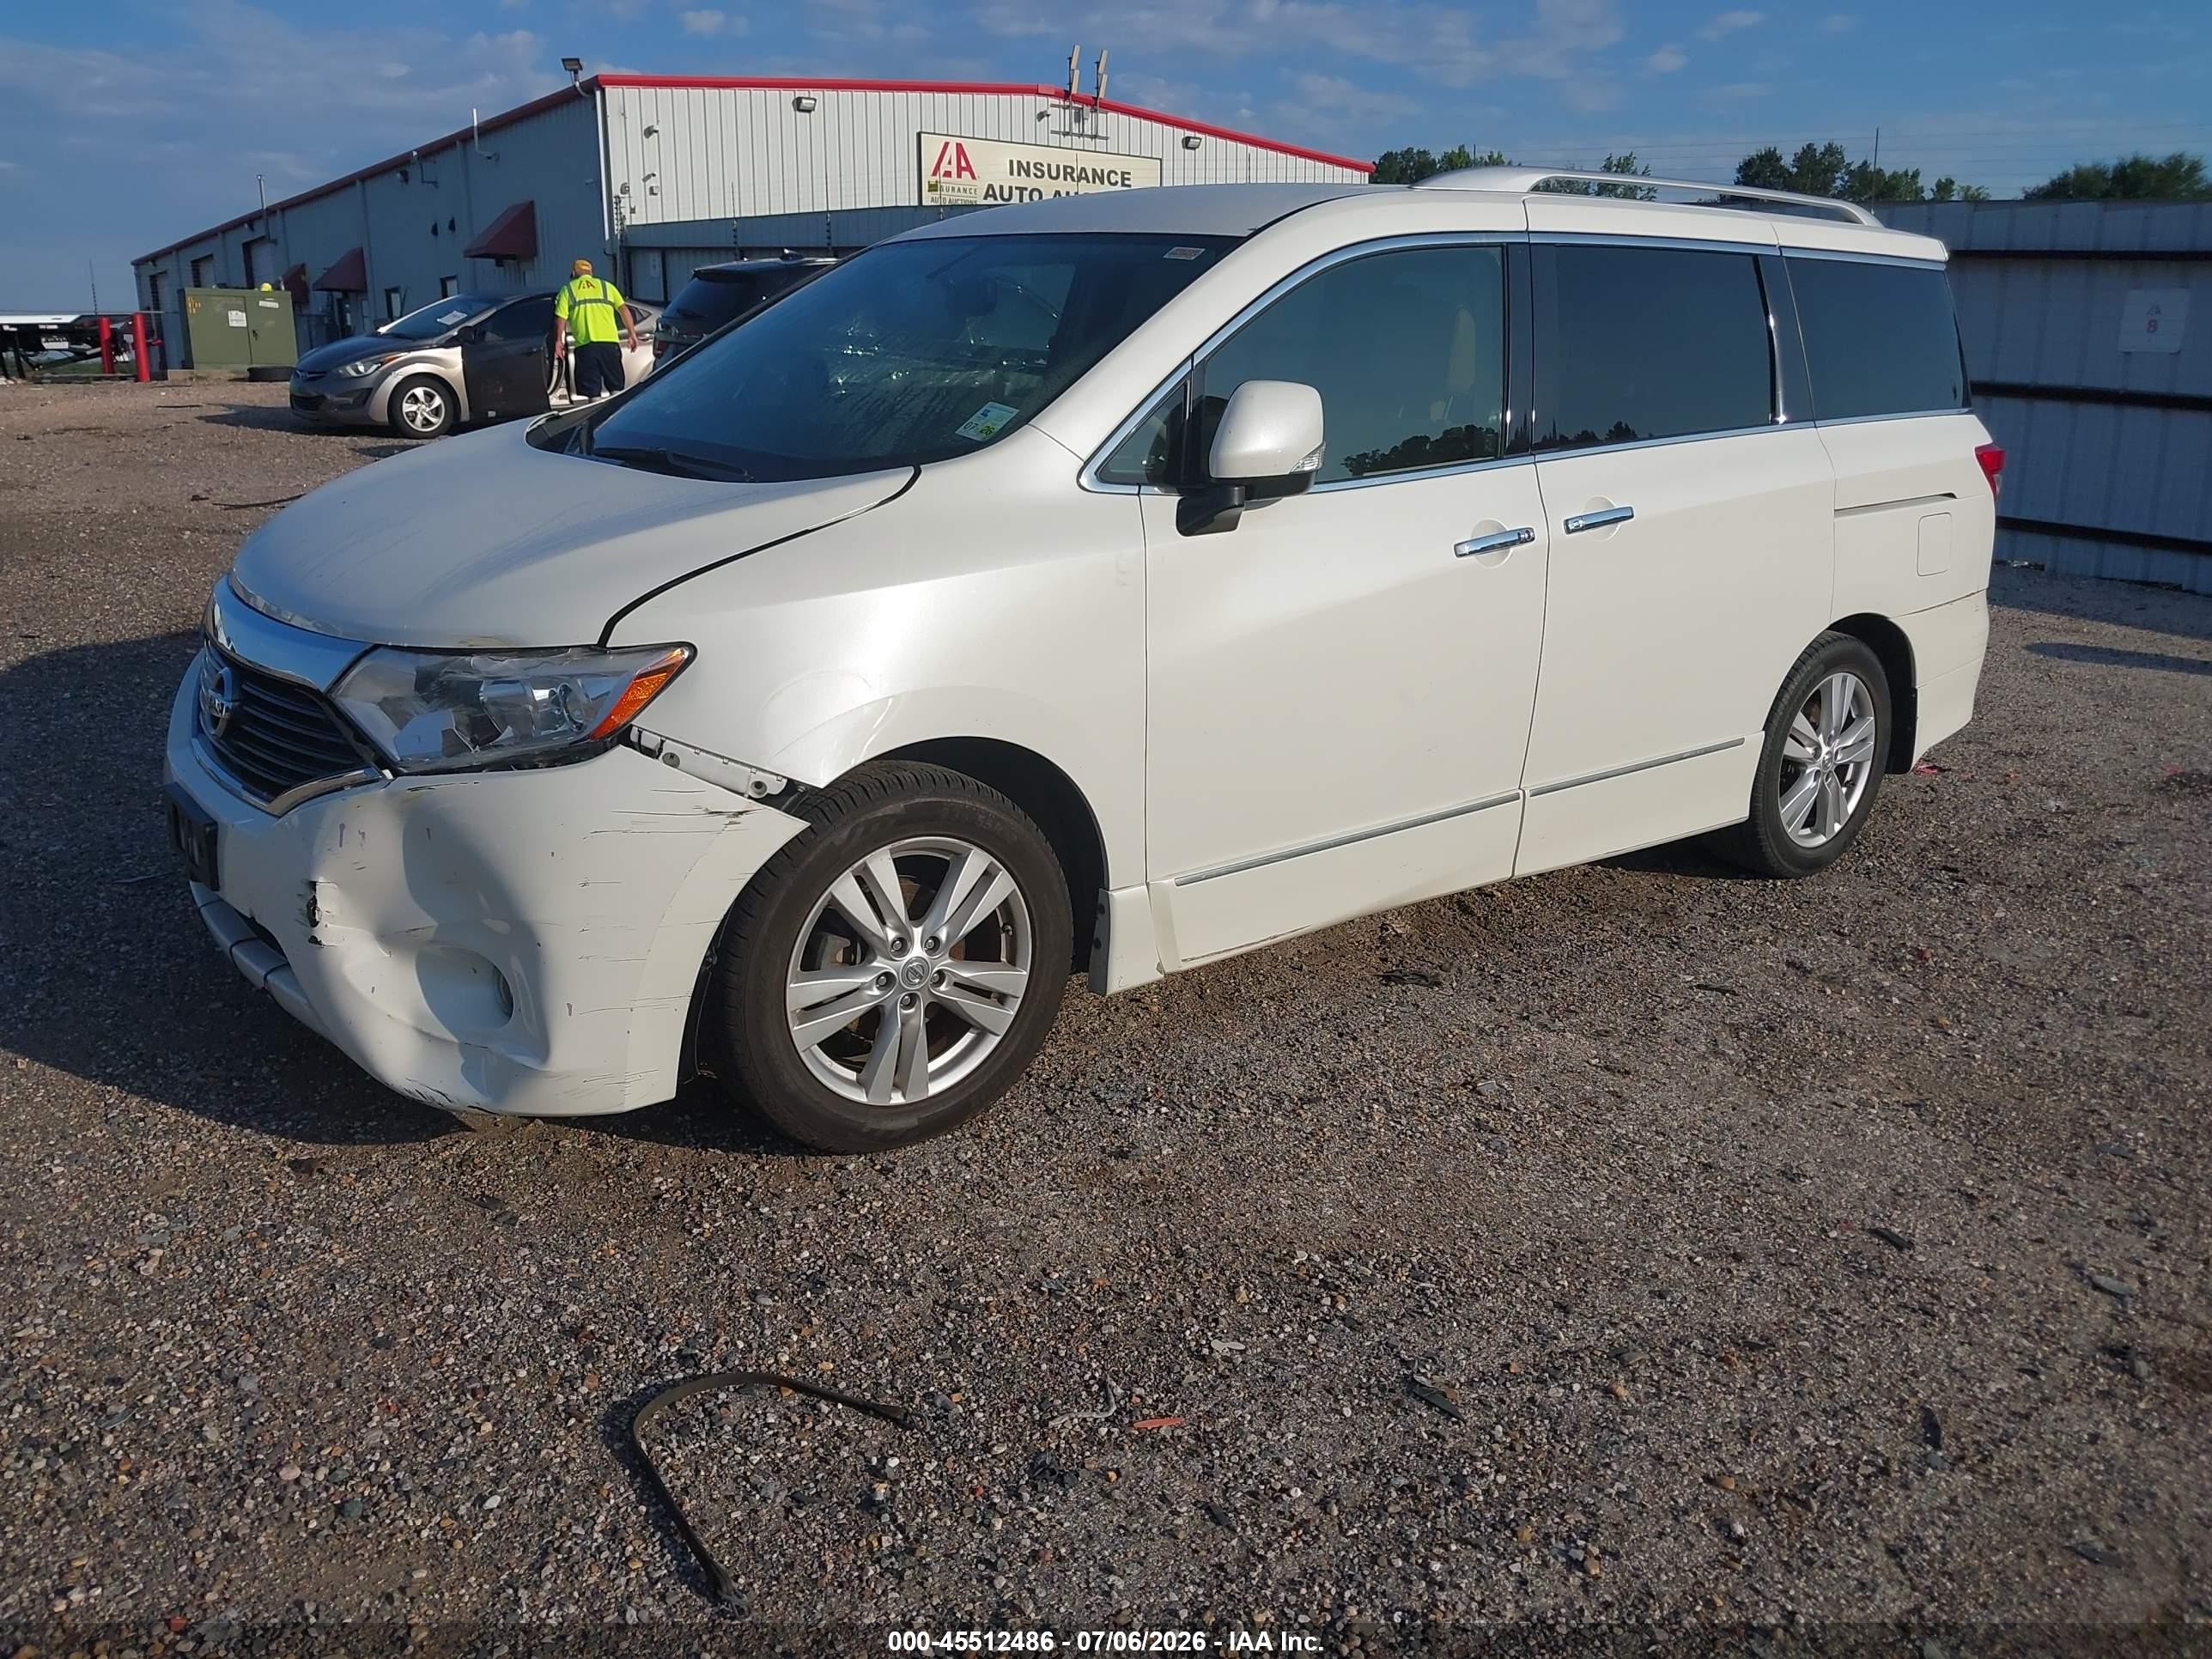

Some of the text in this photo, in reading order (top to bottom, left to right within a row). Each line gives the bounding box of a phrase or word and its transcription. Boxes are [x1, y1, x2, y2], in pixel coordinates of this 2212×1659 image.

[1009, 159, 1132, 187] INSURANCE
[940, 185, 978, 195] SURANCE
[982, 183, 1043, 203] AUTO
